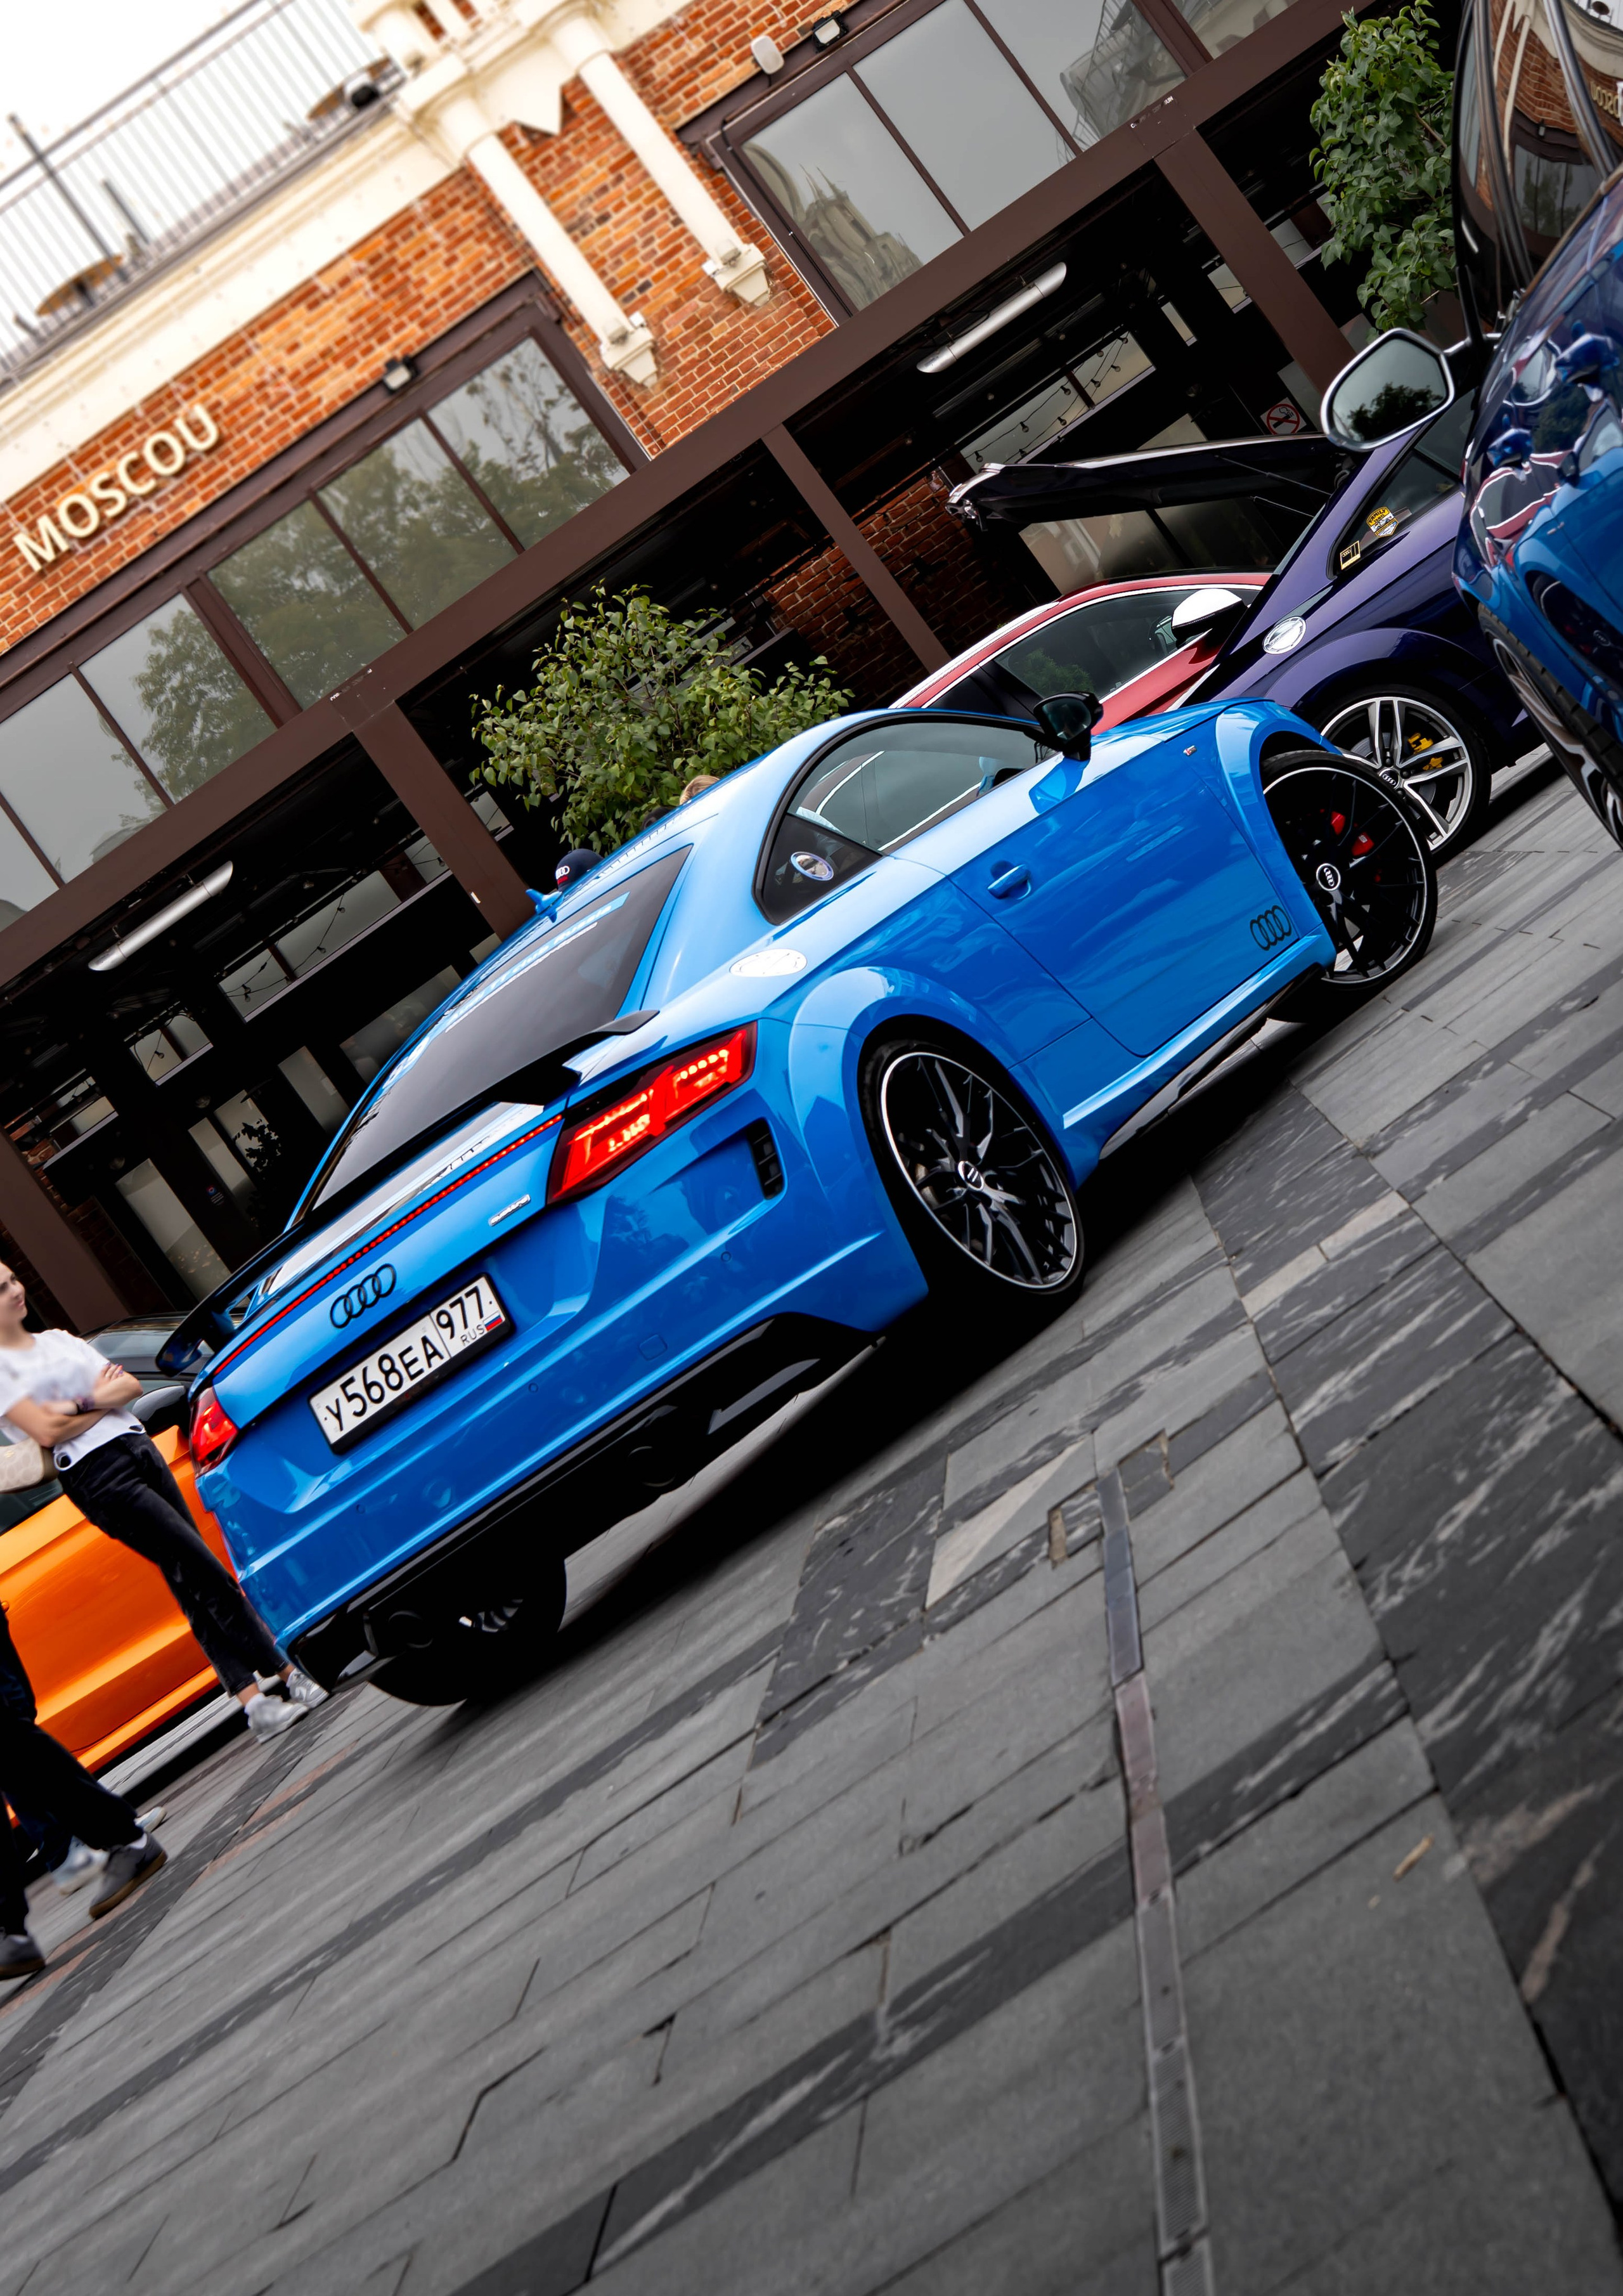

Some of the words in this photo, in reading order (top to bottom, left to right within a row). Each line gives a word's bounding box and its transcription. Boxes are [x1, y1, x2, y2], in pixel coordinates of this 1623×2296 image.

[12, 404, 219, 572] MOSCOU
[1368, 509, 1386, 523] FAMILY
[436, 1285, 484, 1340] 977
[460, 1324, 485, 1346] RUS
